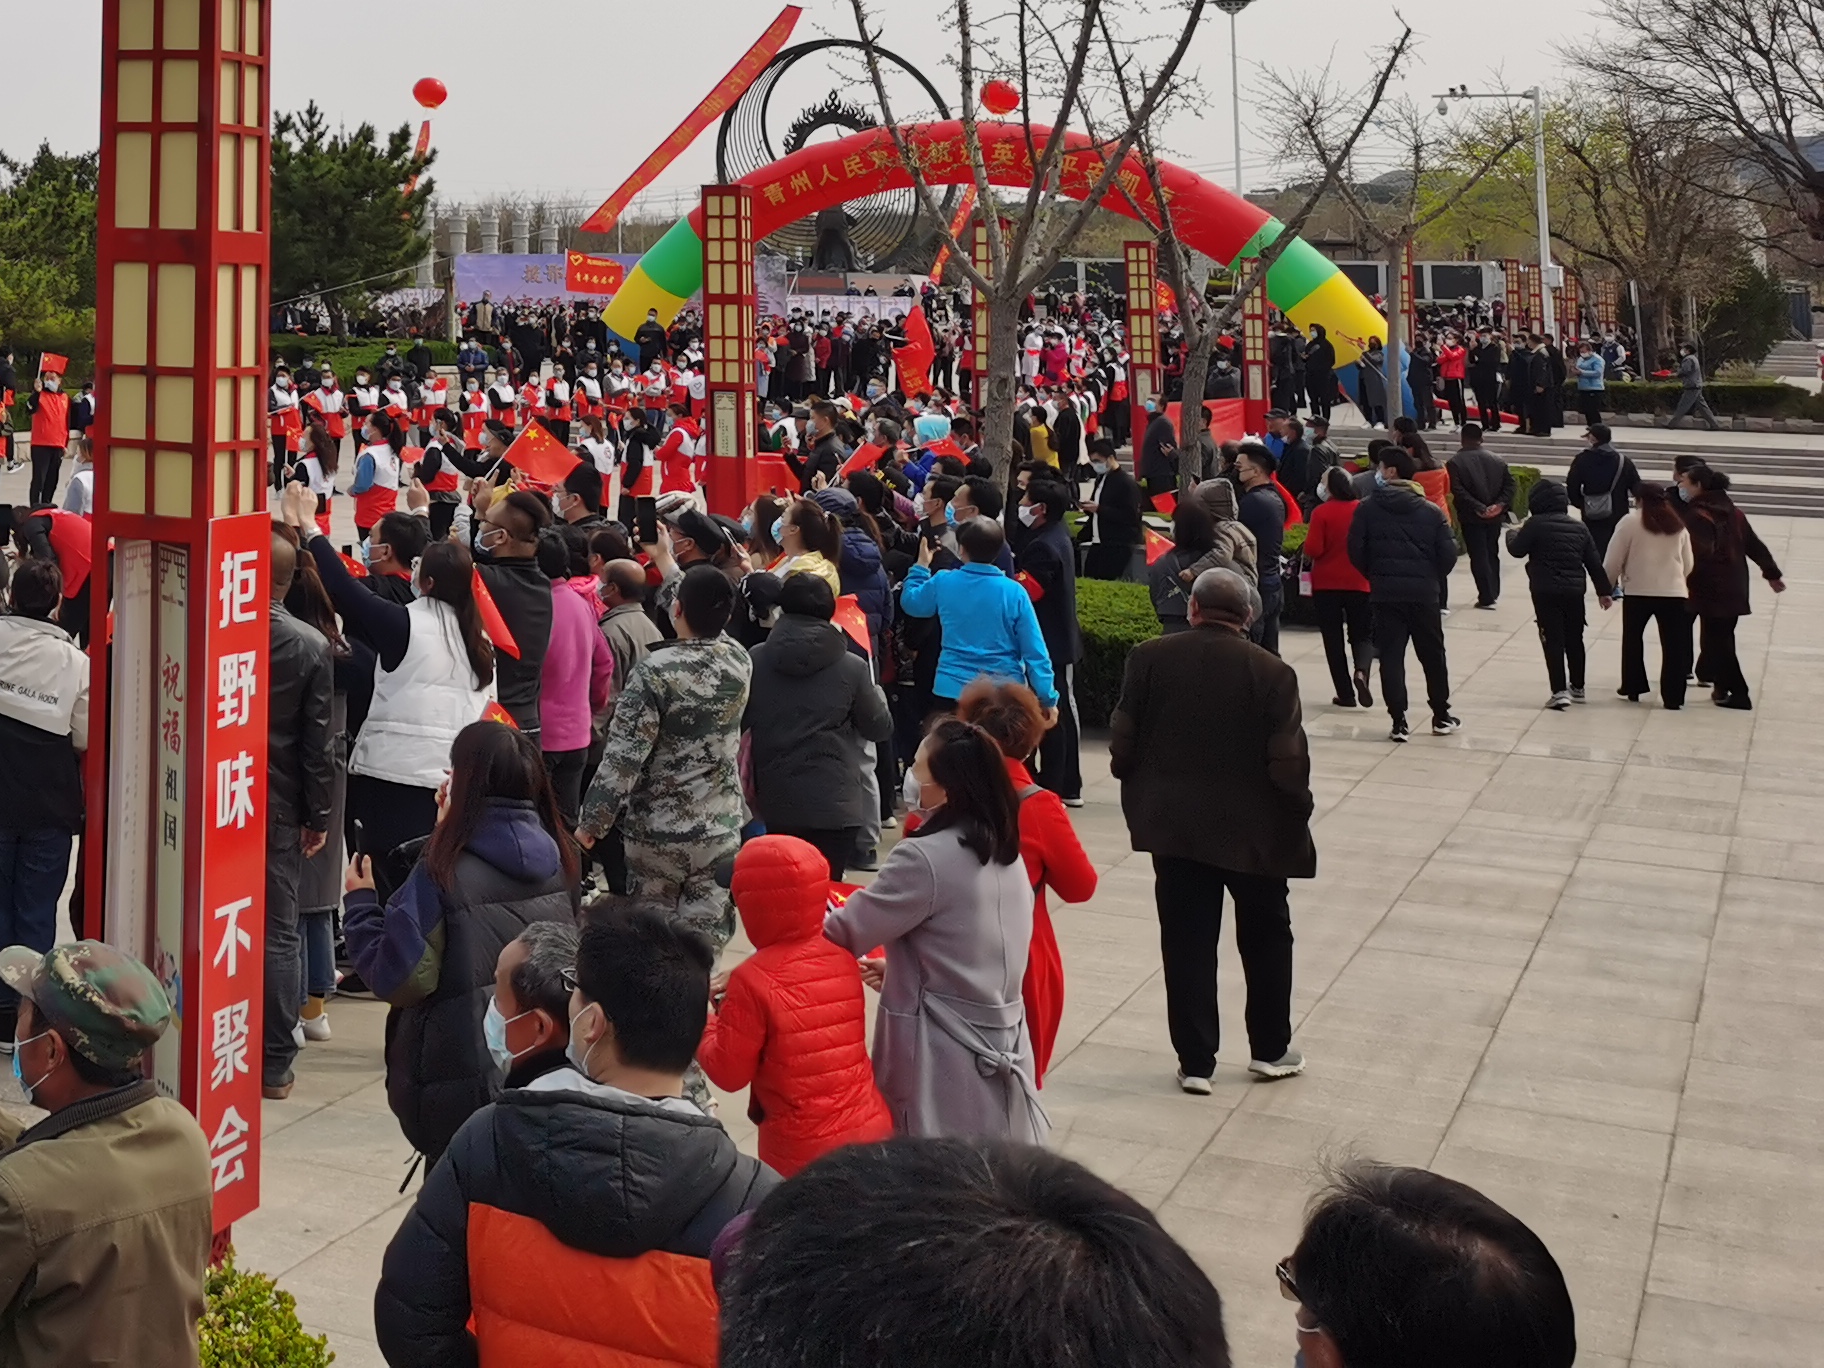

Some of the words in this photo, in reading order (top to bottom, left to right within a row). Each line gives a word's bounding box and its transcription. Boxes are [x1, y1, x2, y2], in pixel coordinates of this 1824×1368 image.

[162, 654, 184, 851] 祝福祖国
[216, 549, 259, 830] 拒野味
[210, 895, 252, 1192] 不聚会
